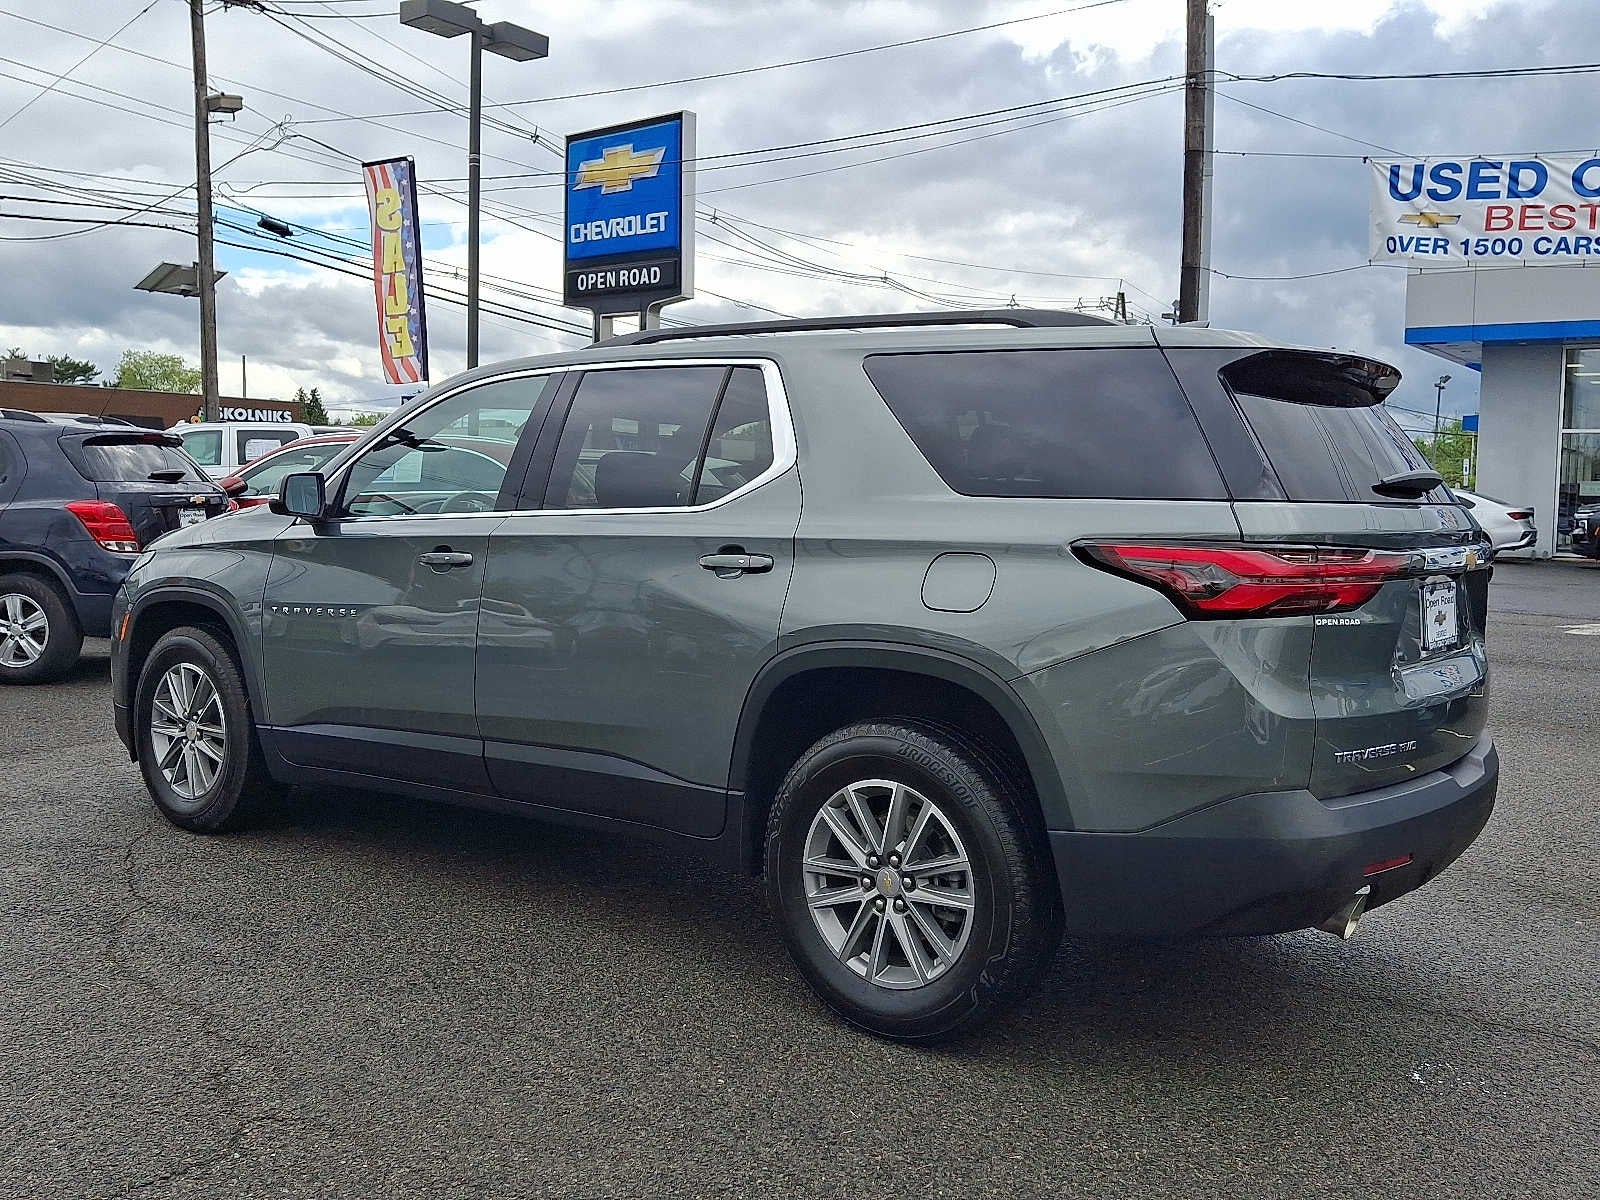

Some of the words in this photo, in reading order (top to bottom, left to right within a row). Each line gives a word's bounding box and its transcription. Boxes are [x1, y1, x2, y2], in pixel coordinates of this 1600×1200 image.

[1389, 160, 1548, 202] USED
[571, 211, 669, 244] CHEVROLET
[1485, 203, 1600, 232] BEST
[1386, 235, 1450, 255] OVER
[1460, 236, 1523, 256] 1500
[577, 271, 616, 291] OPEN
[620, 266, 661, 287] ROAD
[271, 606, 357, 617] TRAVERSE
[1315, 618, 1338, 626] OPEN
[1339, 618, 1361, 626] ROAD
[1334, 743, 1397, 763] TRAVERSE
[896, 743, 983, 811] BRIDGESTON
